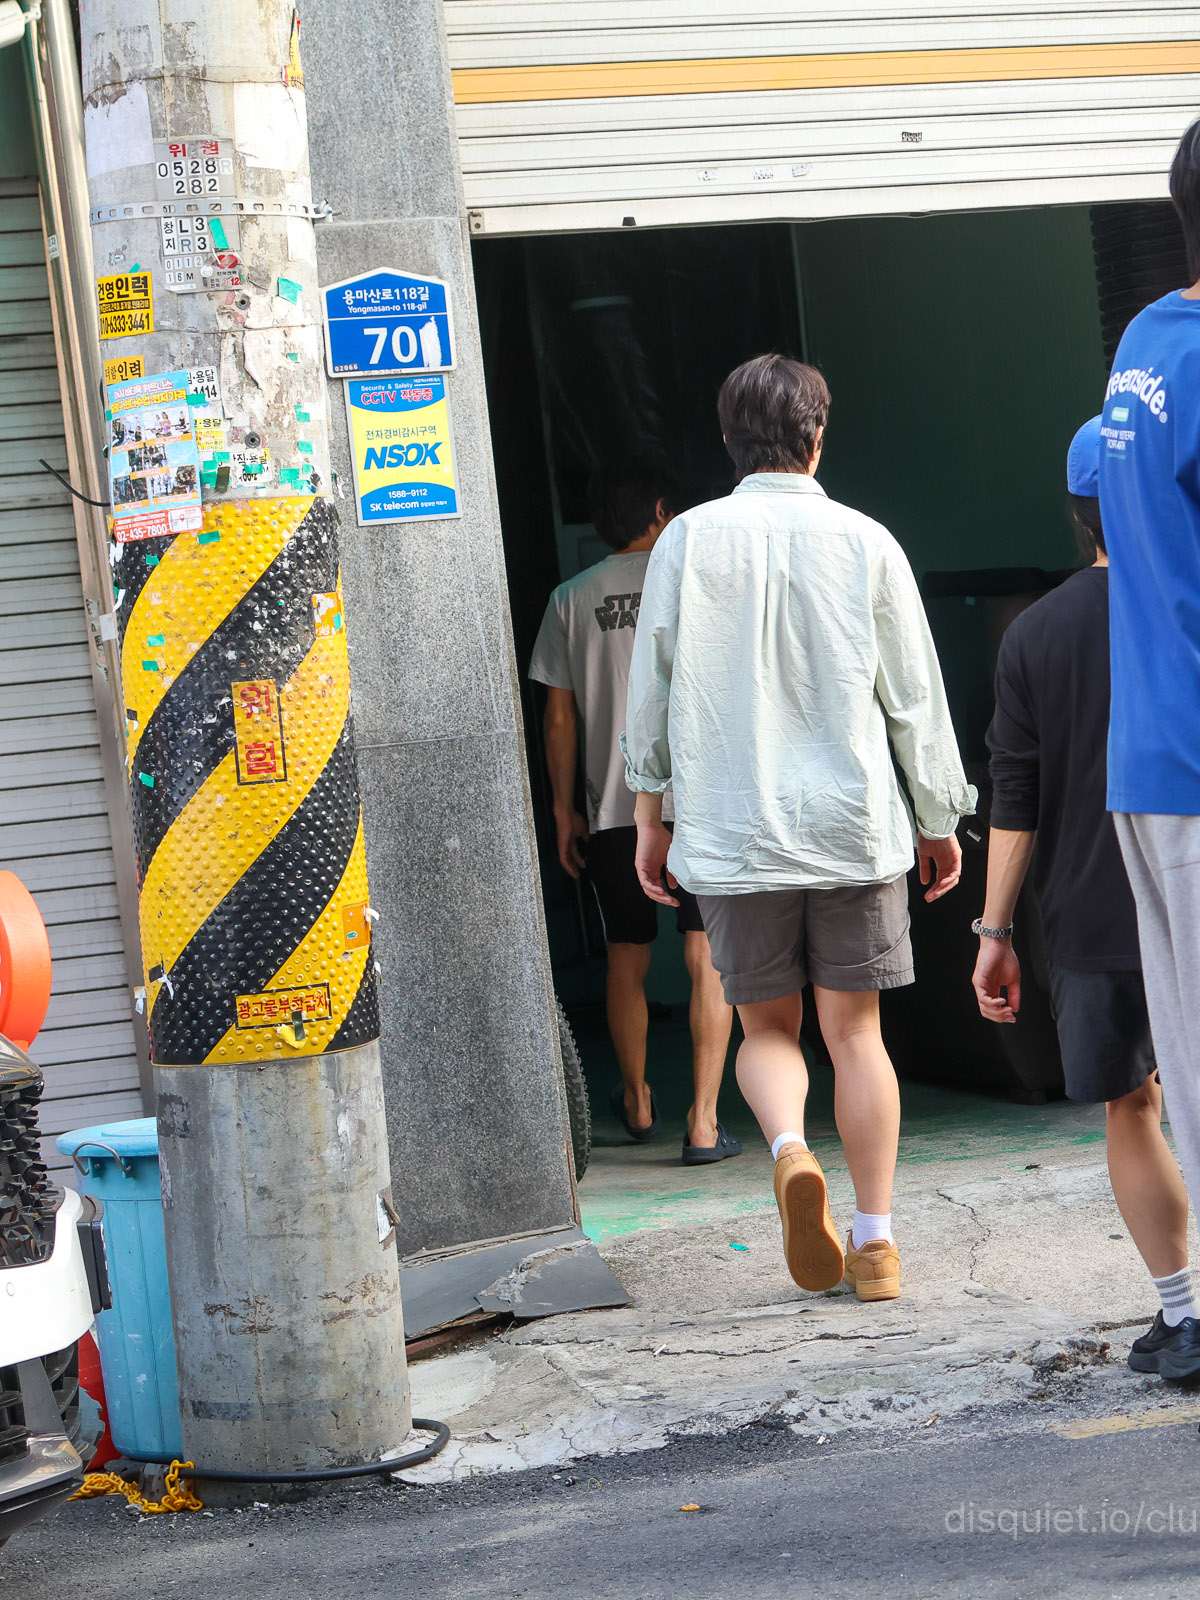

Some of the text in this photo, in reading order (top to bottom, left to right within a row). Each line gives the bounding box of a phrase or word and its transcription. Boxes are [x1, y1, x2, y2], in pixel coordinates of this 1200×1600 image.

[175, 178, 218, 194] 282
[342, 286, 430, 306] 용마산로118길
[347, 301, 427, 315] Yongmasan-ro 118-gil
[363, 325, 418, 364] 70
[334, 363, 359, 372] 02066
[361, 384, 385, 392] Security
[395, 382, 413, 390] Safety
[361, 388, 433, 405] CCTV 작동중
[365, 425, 437, 441] 전자경비감시구역
[363, 442, 443, 471] NSOK
[388, 488, 428, 499] 1588-9112
[370, 503, 382, 512] SK
[383, 501, 419, 511] telecom
[116, 523, 168, 542] 02-435-7800
[595, 592, 642, 614] STA
[596, 609, 640, 632] WA
[240, 685, 277, 775] 위험
